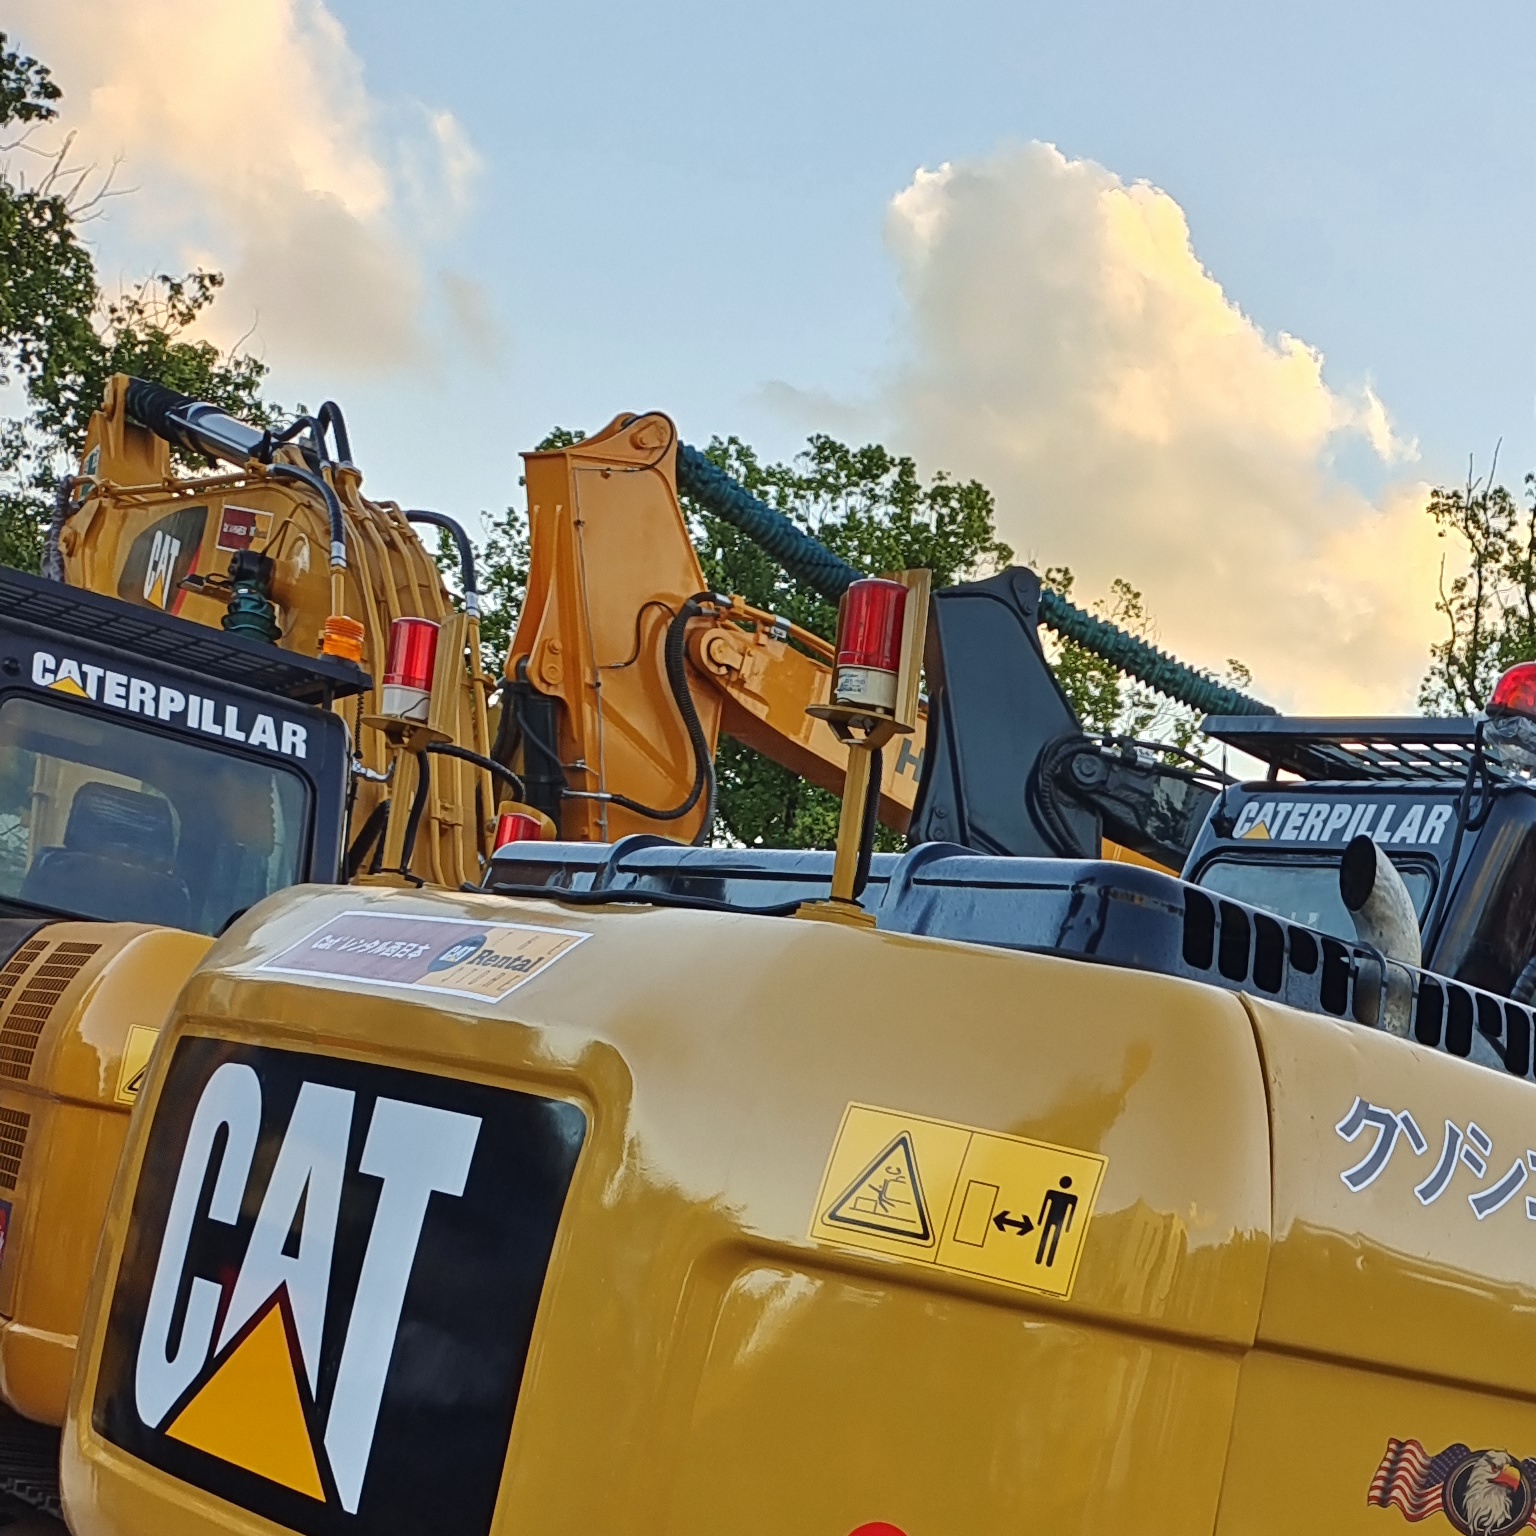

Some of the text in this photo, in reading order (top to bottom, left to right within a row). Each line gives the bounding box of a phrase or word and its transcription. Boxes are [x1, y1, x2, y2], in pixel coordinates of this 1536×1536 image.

[143, 530, 181, 610] CAT
[31, 651, 307, 759] CATERPILLAR
[1232, 801, 1453, 844] CATERPILLAR
[466, 949, 545, 973] Rental
[135, 1062, 483, 1515] CAT
